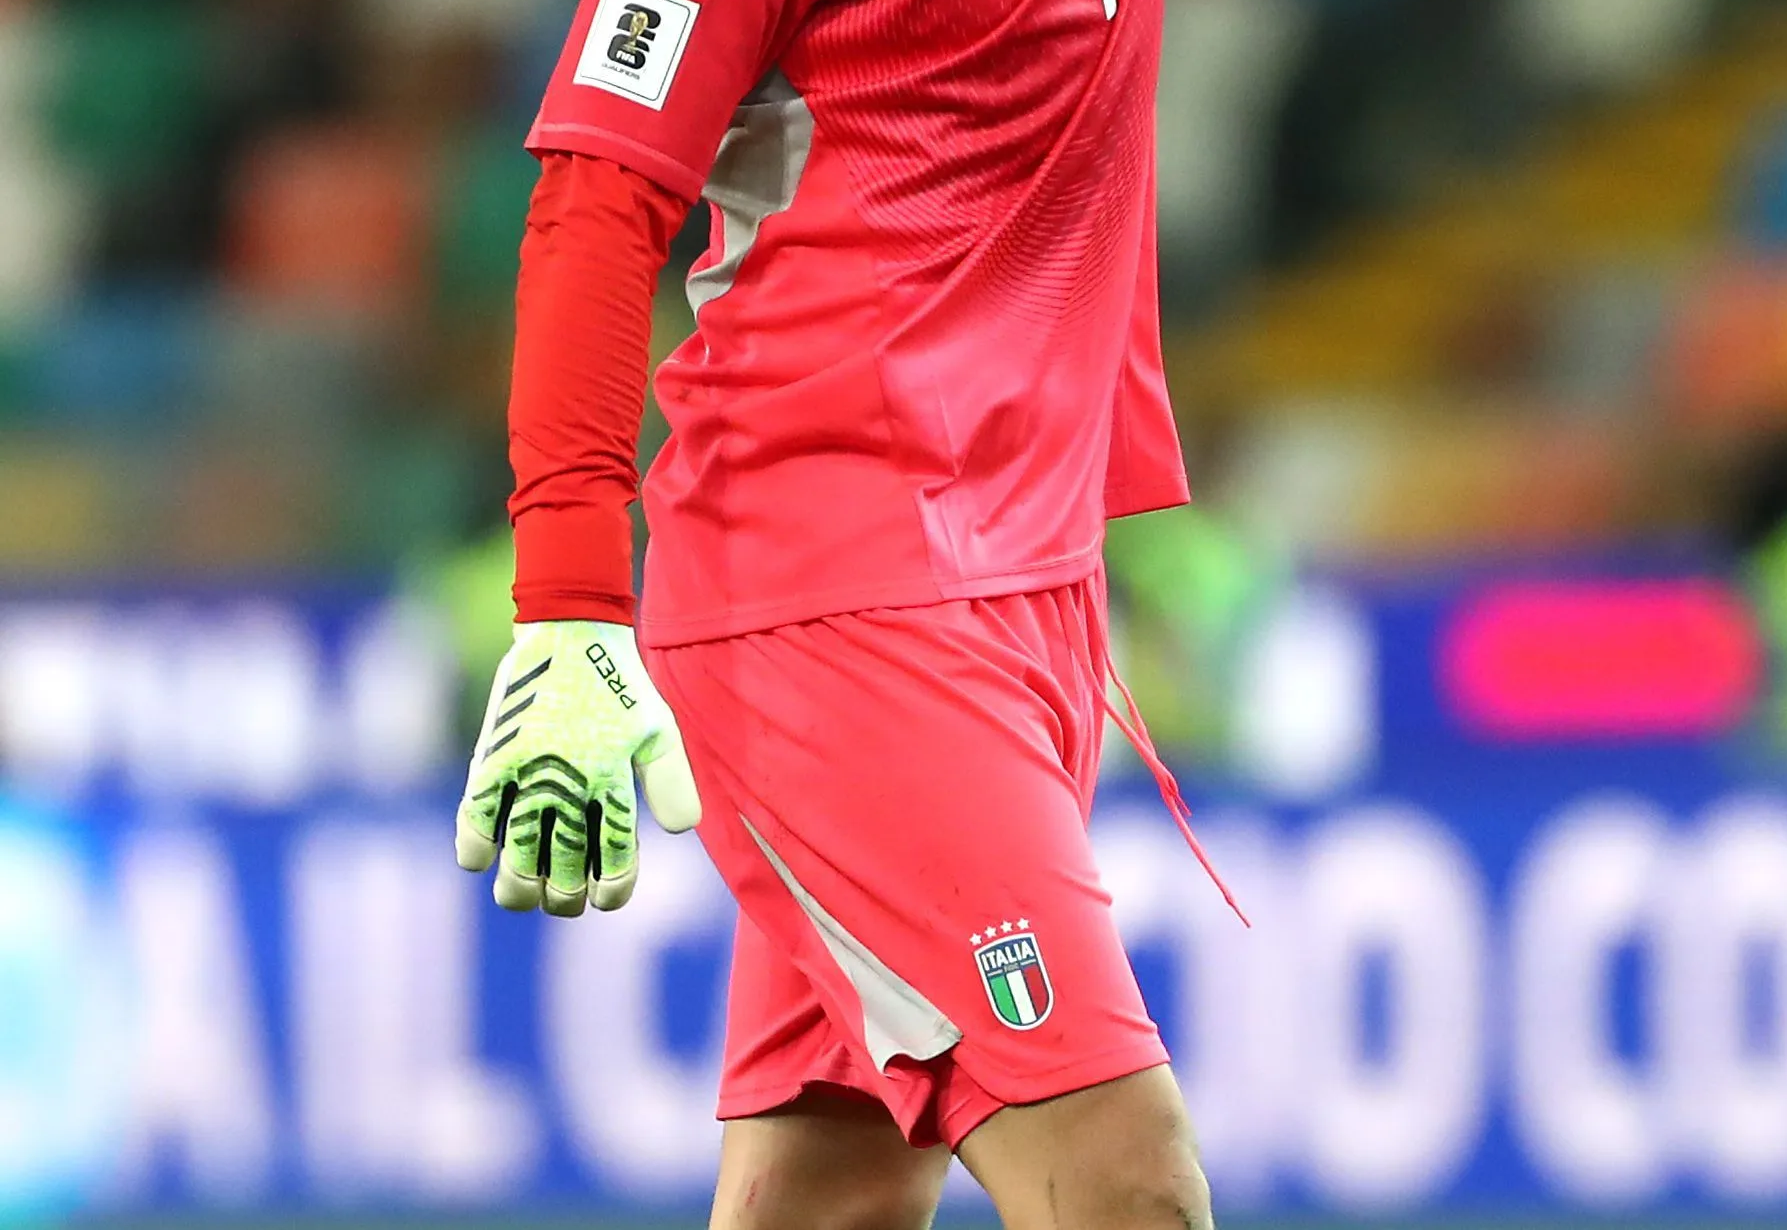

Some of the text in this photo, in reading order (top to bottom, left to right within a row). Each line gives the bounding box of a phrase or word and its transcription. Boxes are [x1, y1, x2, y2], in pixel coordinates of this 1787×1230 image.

[615, 50, 636, 65] FIFA
[586, 643, 637, 710] PRED
[981, 939, 1035, 972] ITALIA
